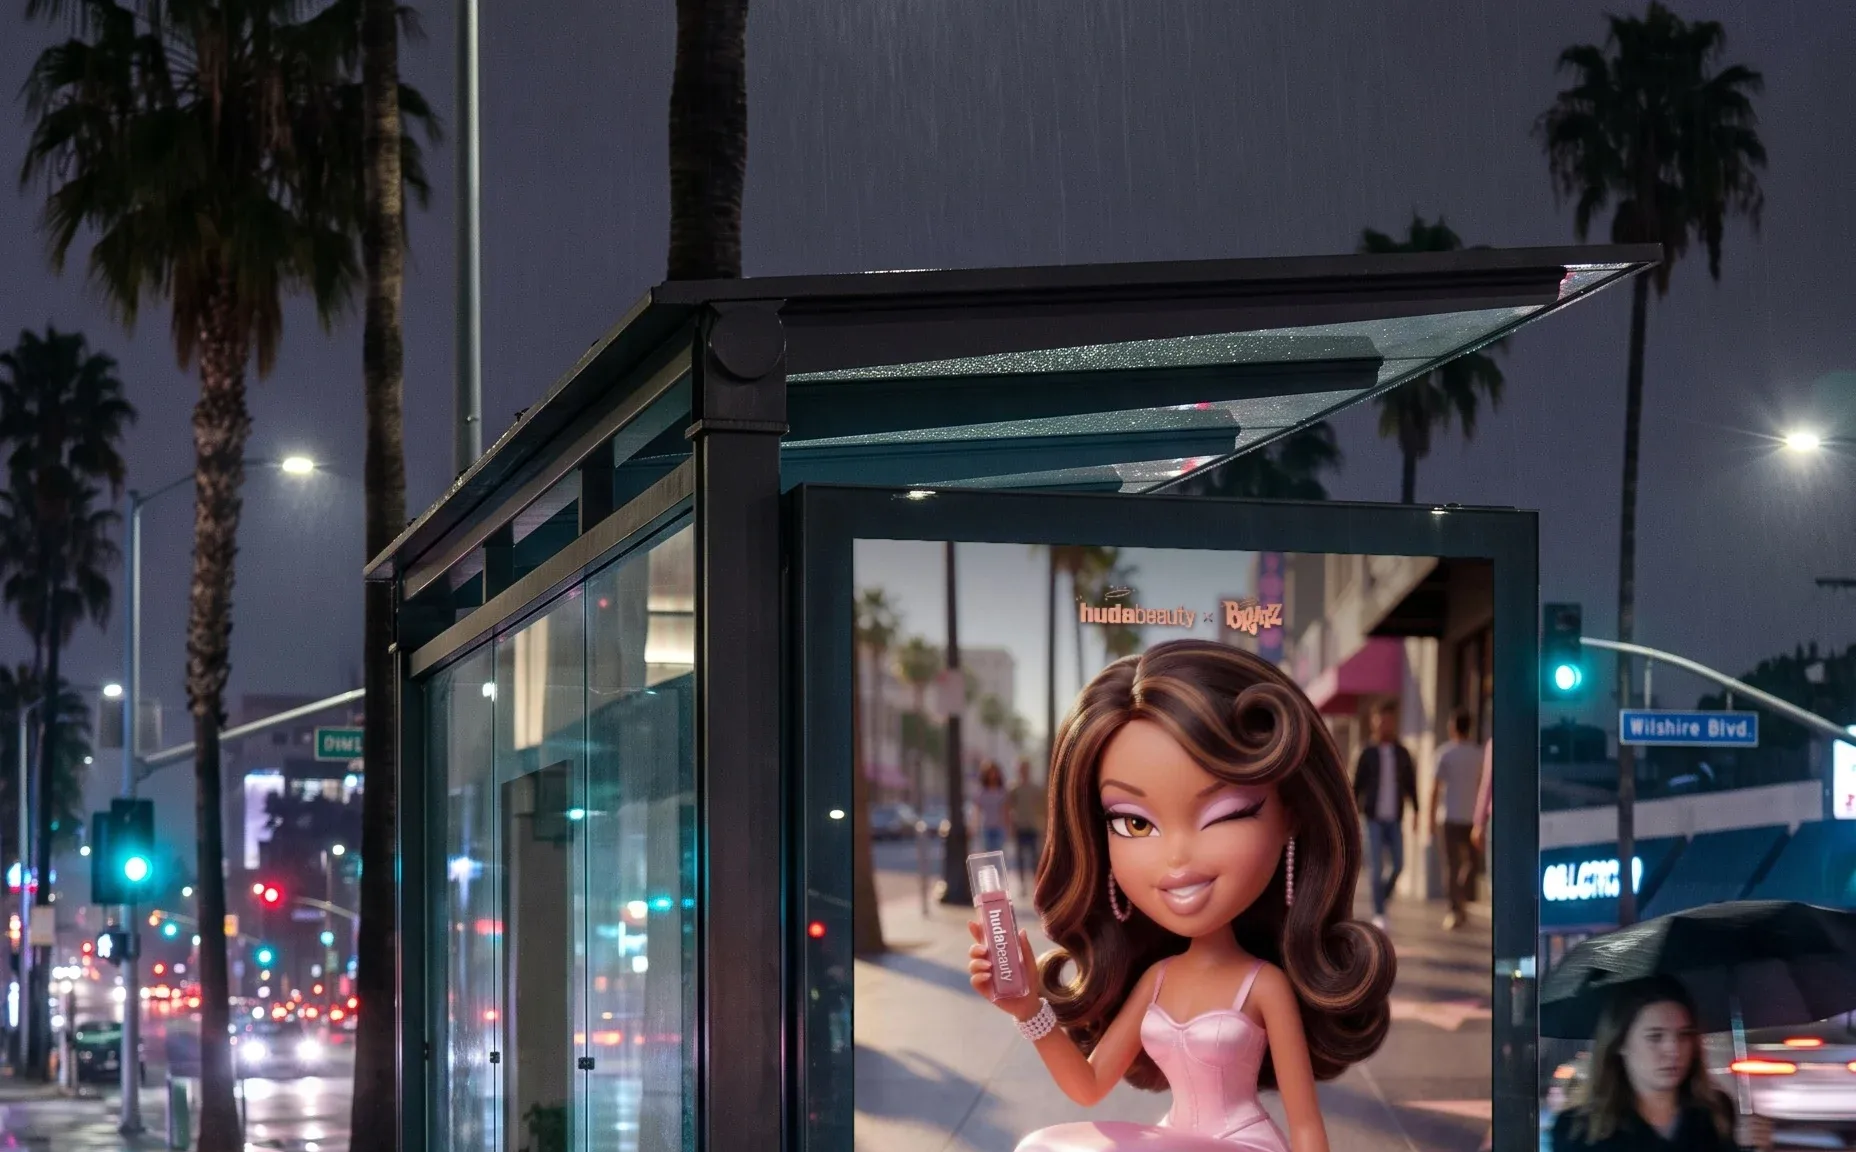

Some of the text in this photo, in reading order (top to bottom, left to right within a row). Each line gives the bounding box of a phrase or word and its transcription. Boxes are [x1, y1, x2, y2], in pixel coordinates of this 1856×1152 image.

[1080, 602, 1195, 628] hudabeauty
[1630, 718, 1699, 737] Wilshire
[988, 909, 1013, 982] hudabeauty
